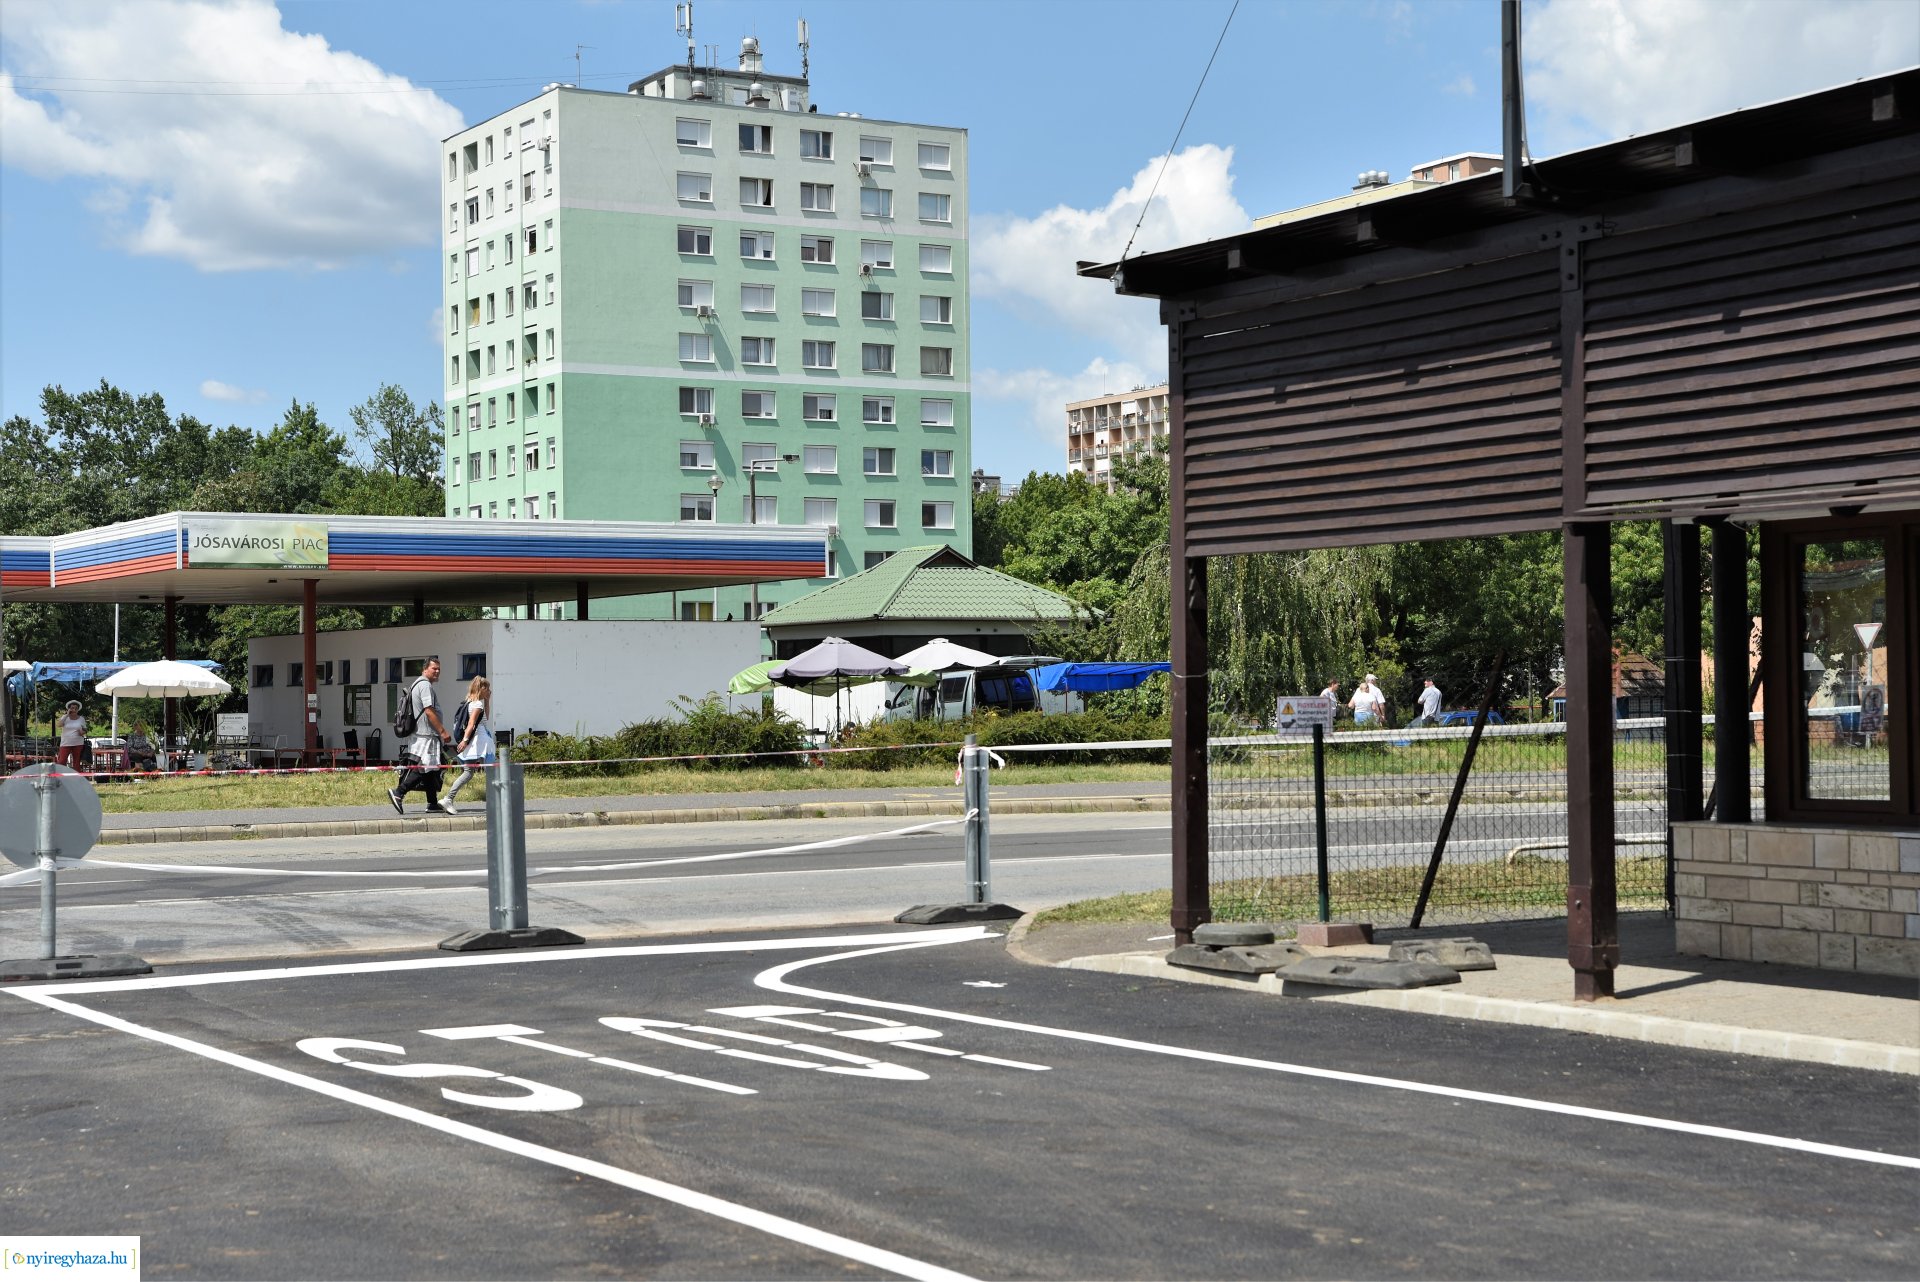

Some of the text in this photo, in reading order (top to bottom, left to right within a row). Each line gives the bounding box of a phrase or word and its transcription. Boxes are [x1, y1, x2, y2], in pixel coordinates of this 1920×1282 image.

[193, 533, 324, 551] JÓSAVÁROSI PIAC
[295, 1004, 1053, 1112] STOP
